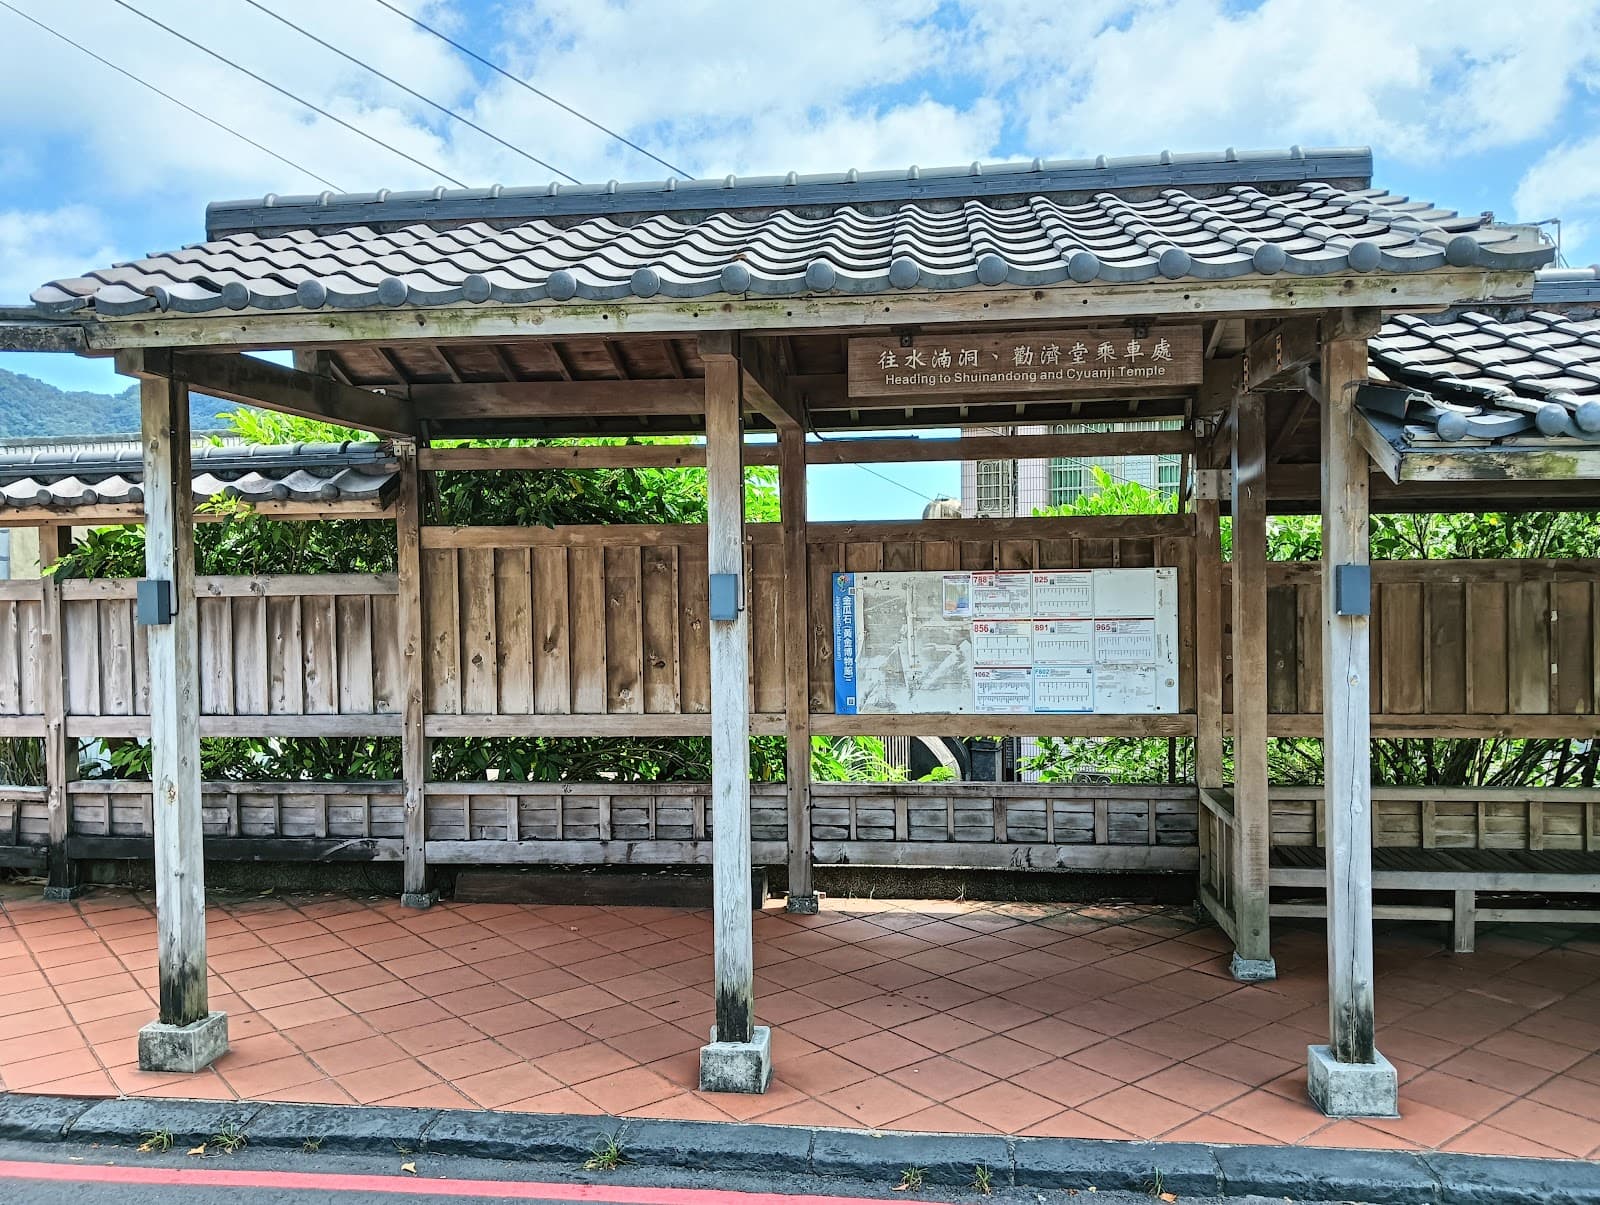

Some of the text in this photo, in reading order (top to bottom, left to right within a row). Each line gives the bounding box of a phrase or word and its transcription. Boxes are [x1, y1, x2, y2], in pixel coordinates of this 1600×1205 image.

[877, 338, 1174, 370] 往水湳洞、勸濟堂乘車處
[885, 365, 1166, 386] Heading to Shuinandong and Cyuanji Temple
[974, 624, 989, 633] 856
[1095, 623, 1111, 631] 965
